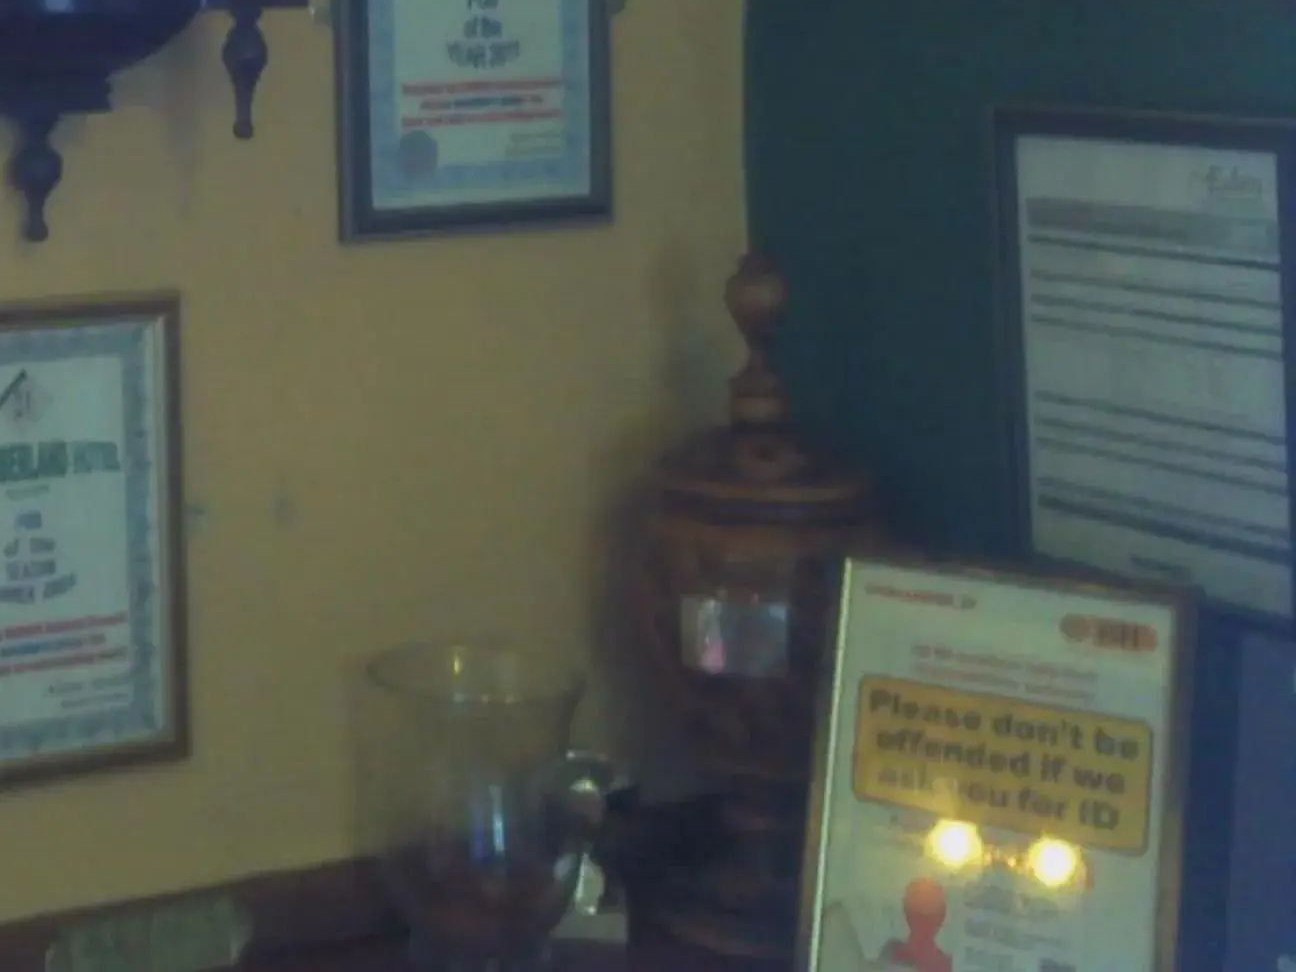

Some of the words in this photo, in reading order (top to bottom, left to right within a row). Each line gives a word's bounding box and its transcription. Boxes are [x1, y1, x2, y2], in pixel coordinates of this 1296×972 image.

[869, 689, 982, 731] Please
[991, 714, 1082, 749] don't
[1094, 727, 1139, 761] be
[877, 729, 1030, 776] offended
[1041, 753, 1065, 782] if
[1073, 767, 1124, 793] we
[1019, 786, 1066, 820] for
[1079, 798, 1120, 830] ID
